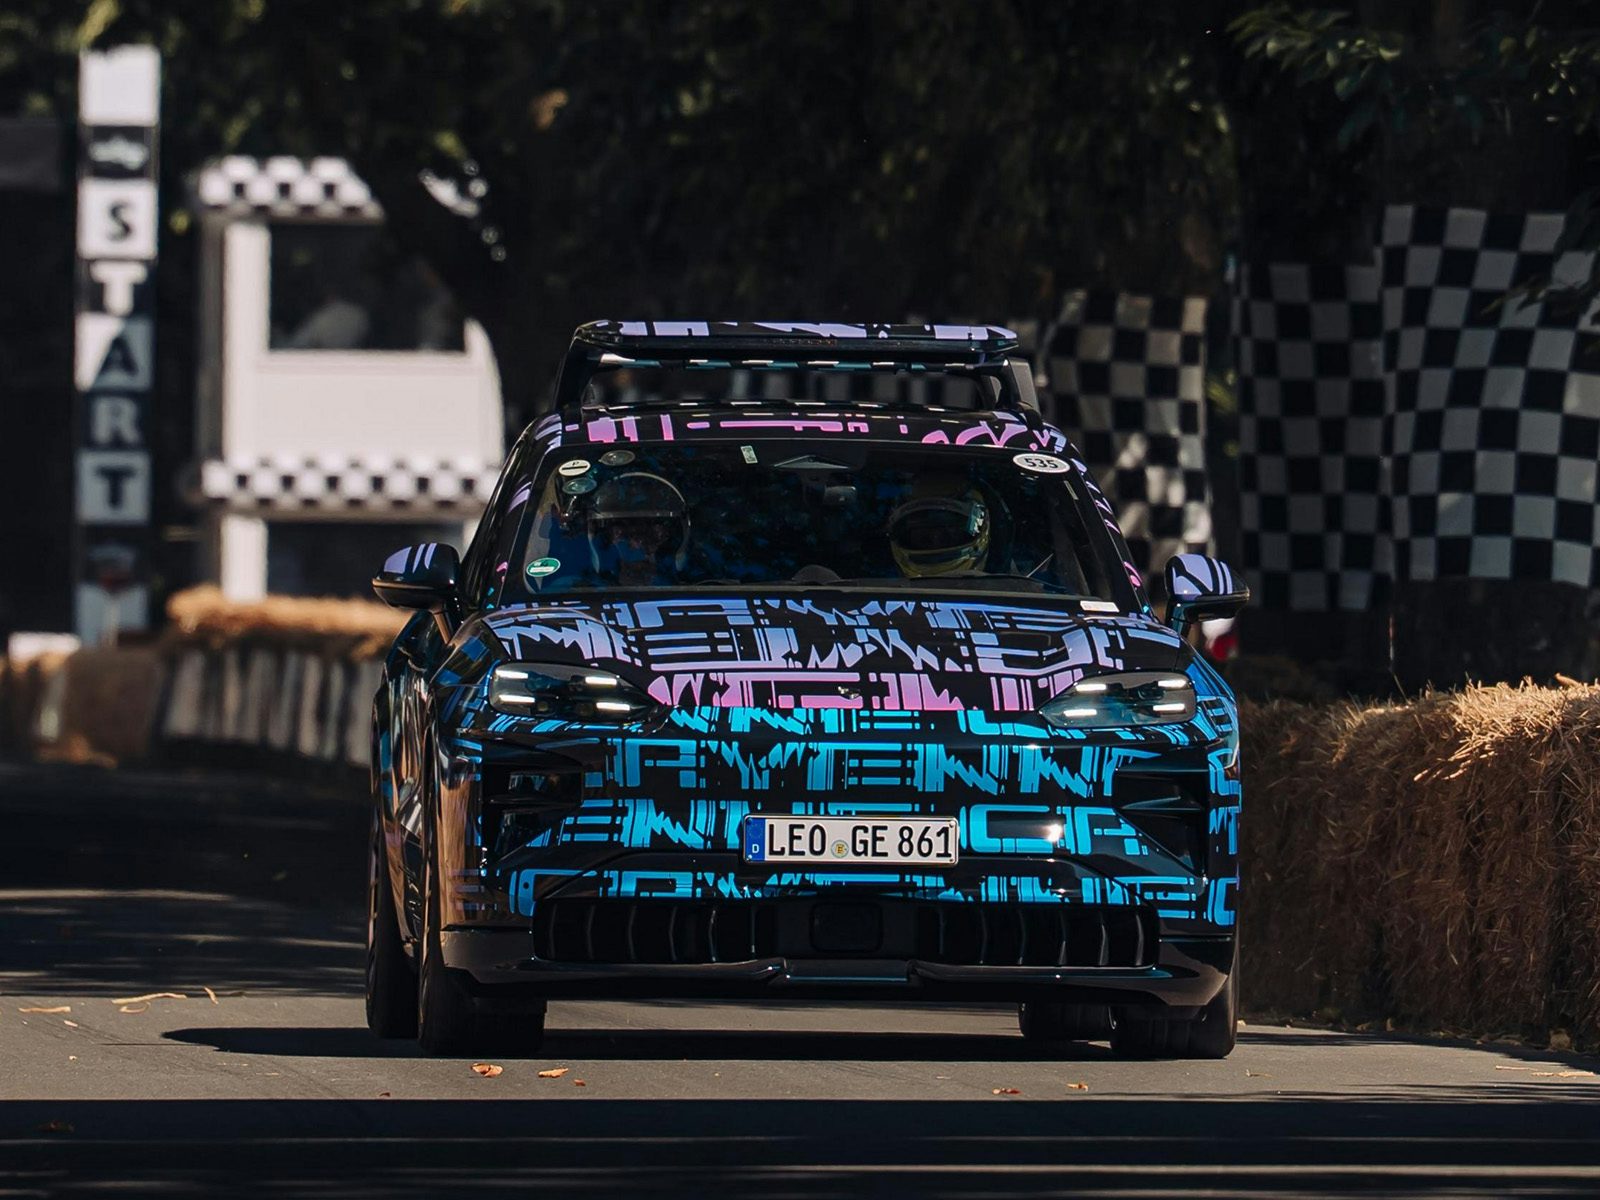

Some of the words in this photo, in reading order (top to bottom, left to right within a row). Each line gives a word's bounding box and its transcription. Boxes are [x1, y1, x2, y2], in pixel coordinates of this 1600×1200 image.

[89, 203, 147, 508] START
[1024, 457, 1059, 469] 535
[752, 843, 760, 854] D
[768, 824, 827, 857] LEO
[851, 825, 889, 858] GE
[897, 825, 953, 858] 861
